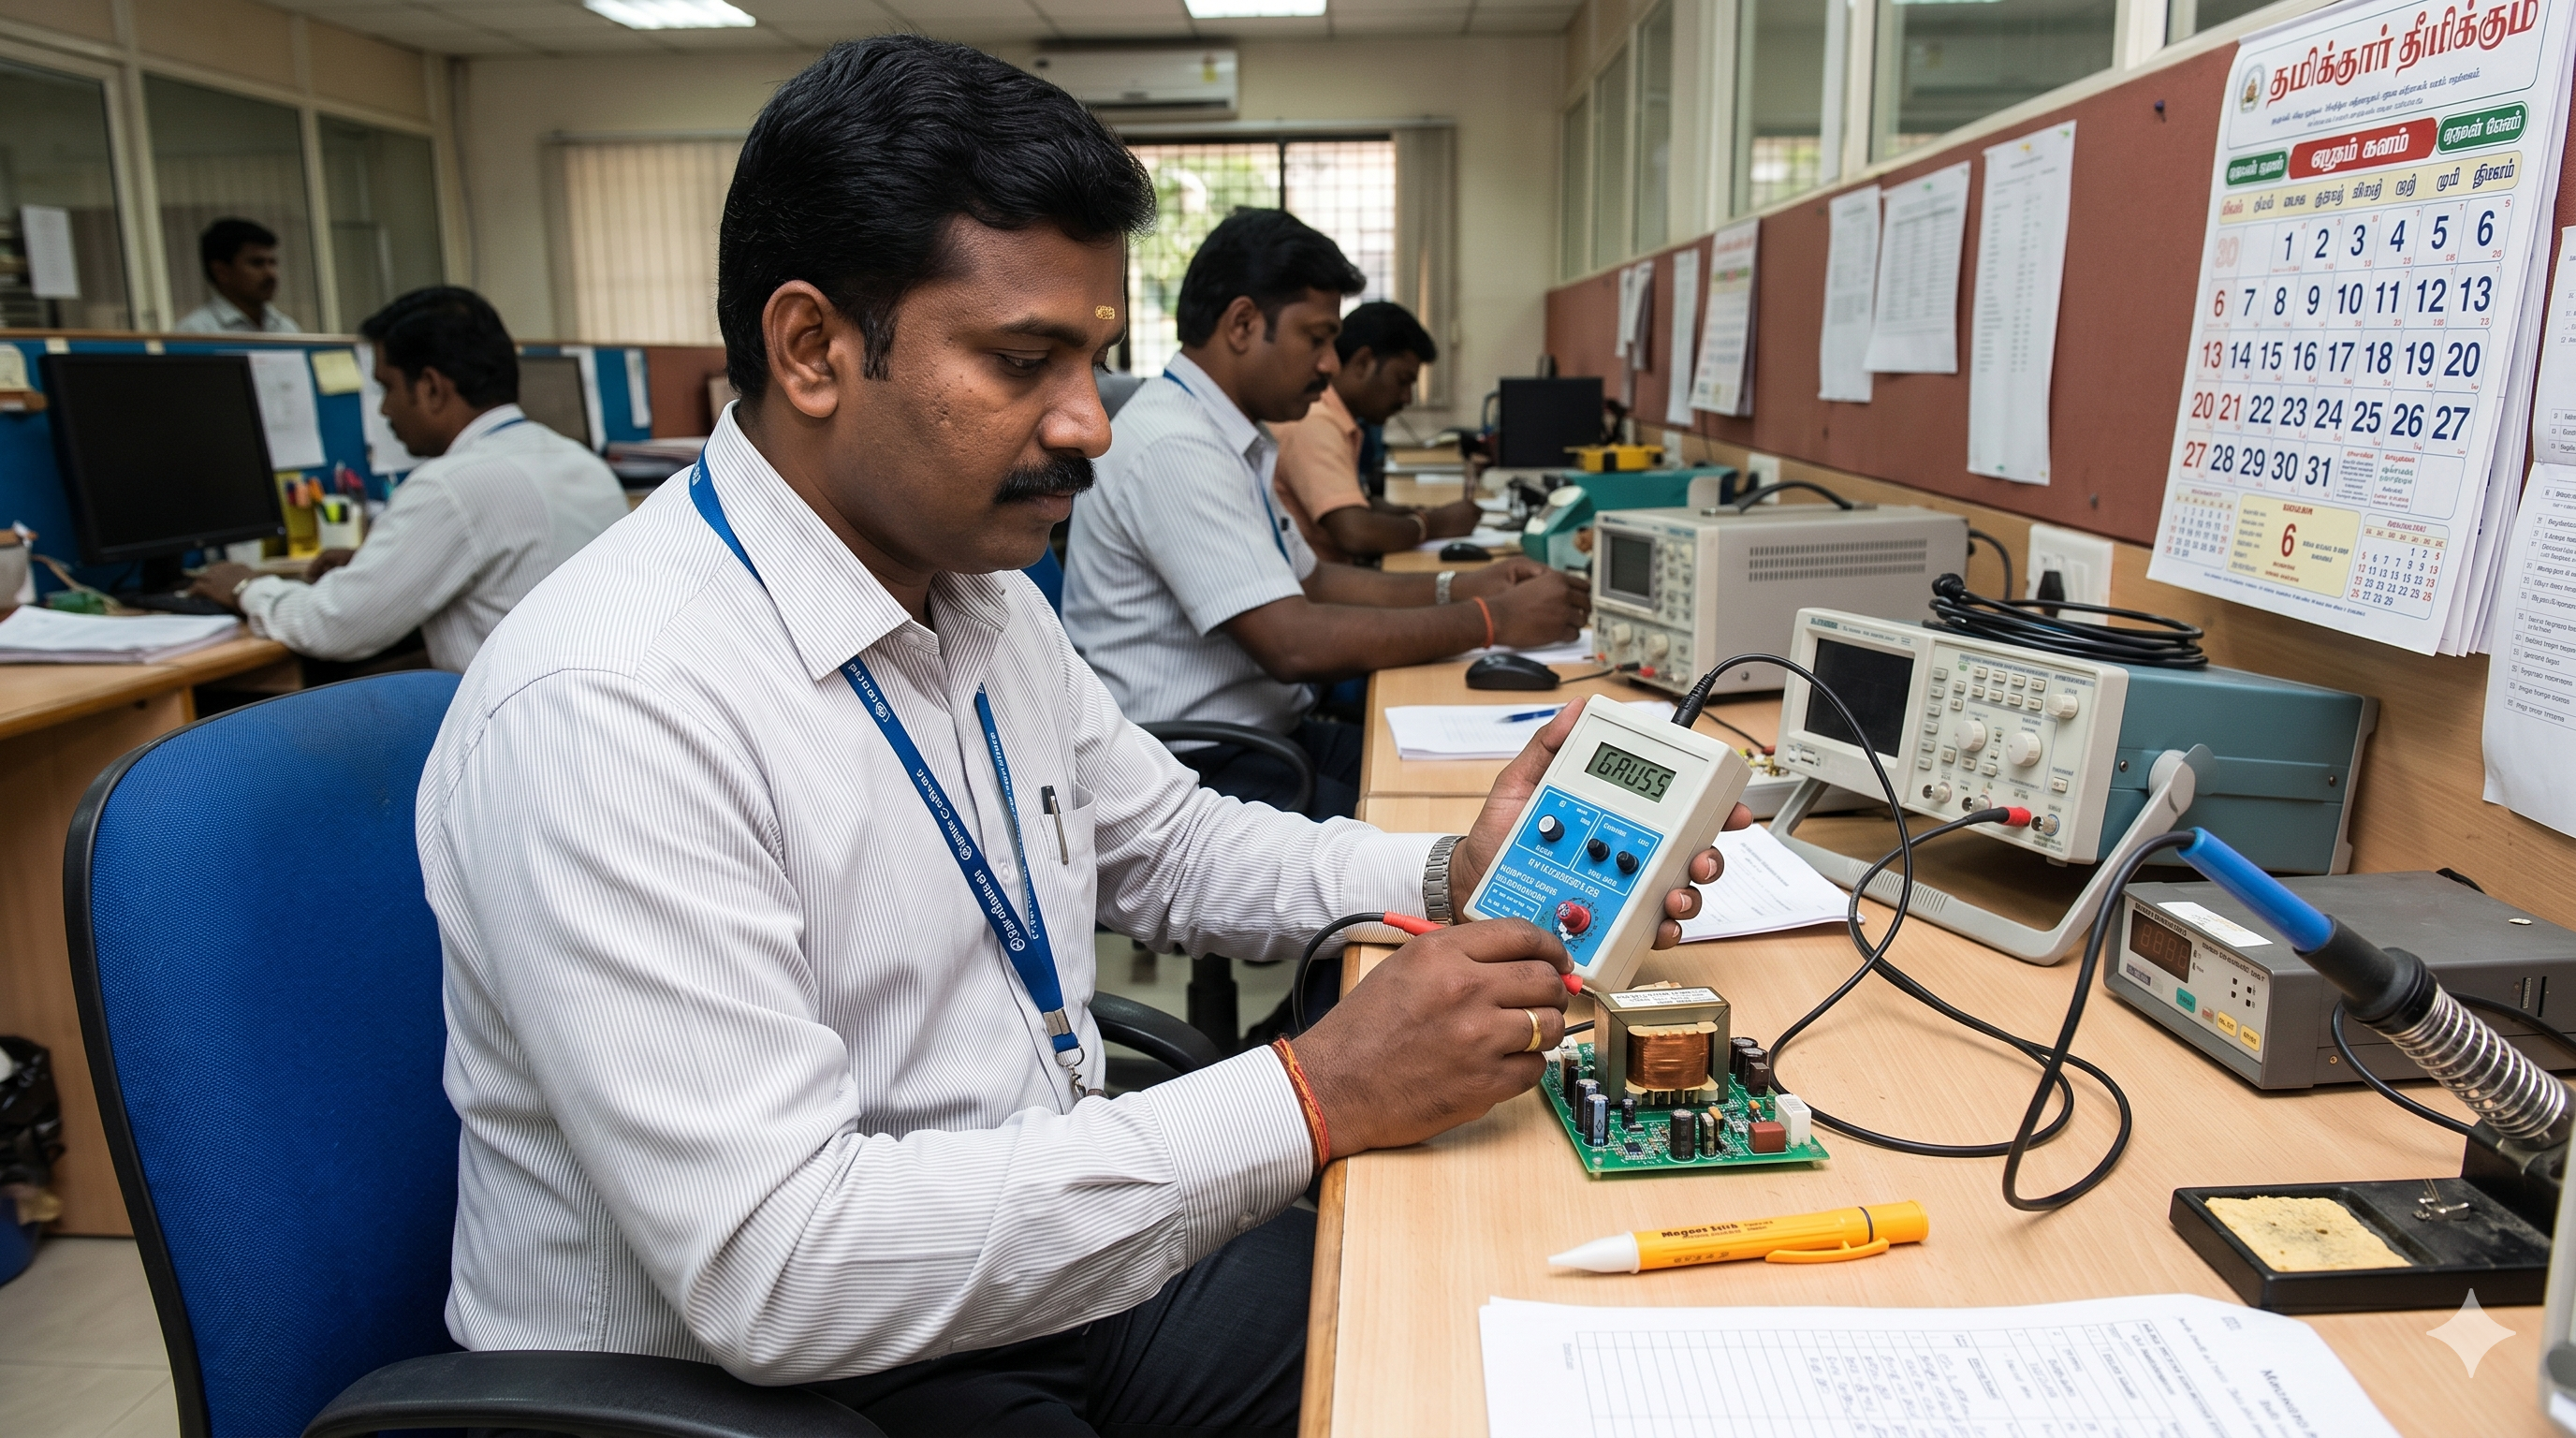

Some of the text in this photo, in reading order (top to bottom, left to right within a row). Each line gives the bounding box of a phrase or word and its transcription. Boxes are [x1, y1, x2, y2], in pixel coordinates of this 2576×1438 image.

[2286, 233, 2292, 260] 1
[2315, 229, 2329, 258] 2
[2351, 225, 2365, 256] 3
[2390, 220, 2405, 252] 4
[2432, 215, 2449, 249] 5
[2478, 211, 2495, 246] 6
[2215, 276, 2492, 316] 6 7 8 9 10 11 12 13
[2204, 342, 2480, 377] 13 14 15 16 17 18 19 20
[2192, 392, 2470, 440] 20 21 22 23 24 25 26 27
[2183, 441, 2206, 467] 27
[2211, 445, 2234, 472] 28
[2240, 448, 2264, 477] 29
[2272, 451, 2298, 481] 30
[2305, 456, 2331, 487] 31
[2282, 523, 2296, 557] 6
[1597, 750, 1673, 799] GAUSS
